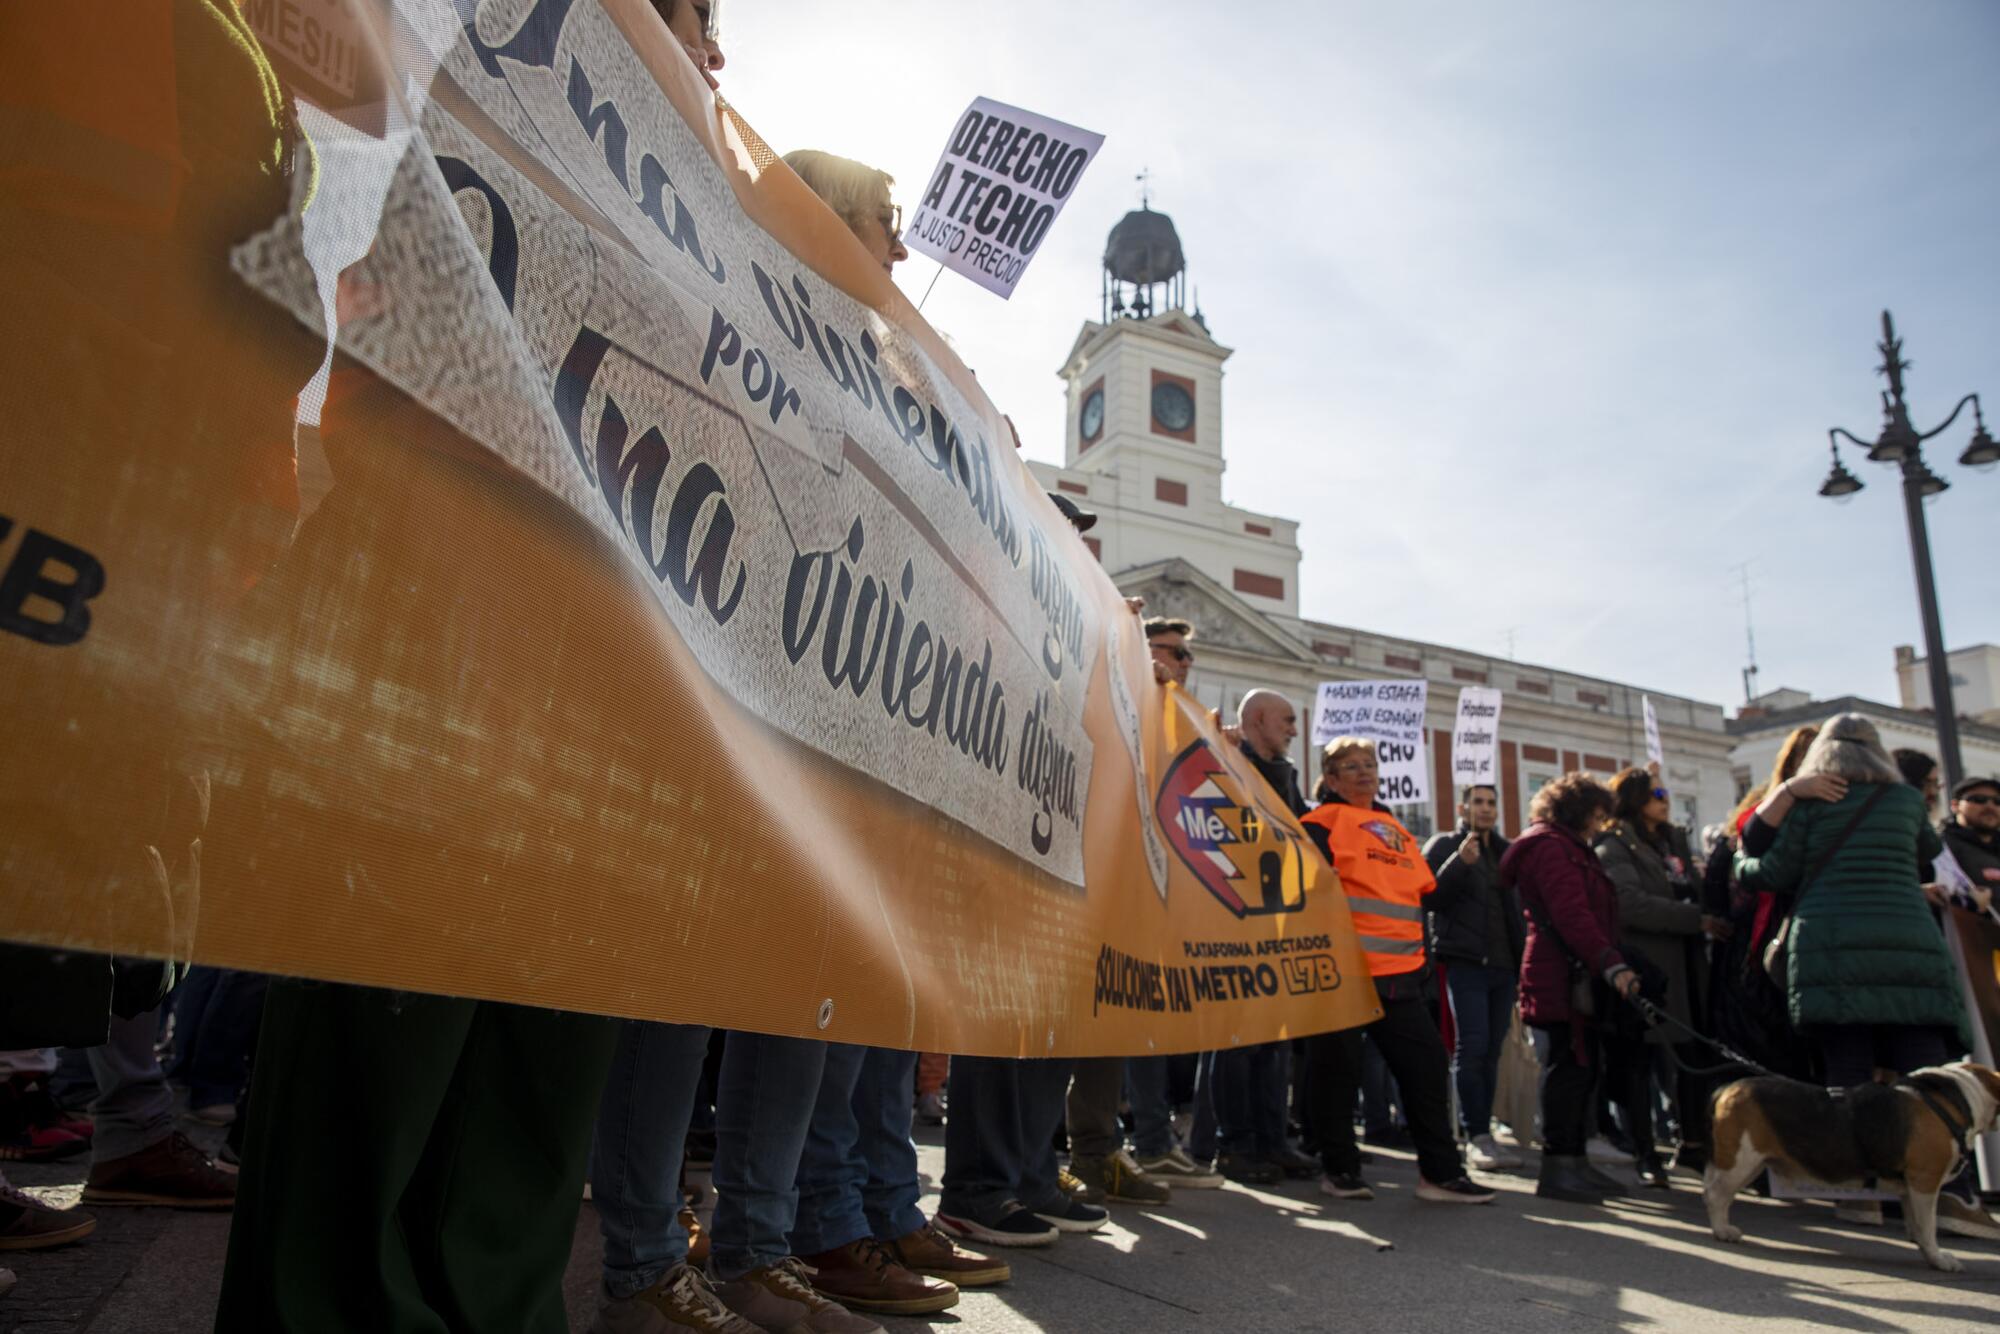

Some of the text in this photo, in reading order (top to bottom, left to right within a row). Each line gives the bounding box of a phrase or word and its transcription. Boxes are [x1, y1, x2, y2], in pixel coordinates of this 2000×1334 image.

[950, 110, 1088, 200] DERECHO
[923, 161, 1055, 256] A TECHO
[911, 211, 1027, 287] A JUSTO PRECIO!
[701, 306, 801, 424] por
[751, 260, 1021, 569] vivienda
[782, 514, 1010, 777] vivienda
[1017, 687, 1080, 856] digna.
[1355, 706, 1373, 723] EN
[1183, 804, 1236, 841] Me
[1377, 775, 1420, 799] CHO.
[1183, 934, 1331, 958] PLATAFORMA AFECTADOS
[1190, 953, 1342, 1002] METRO L7B
